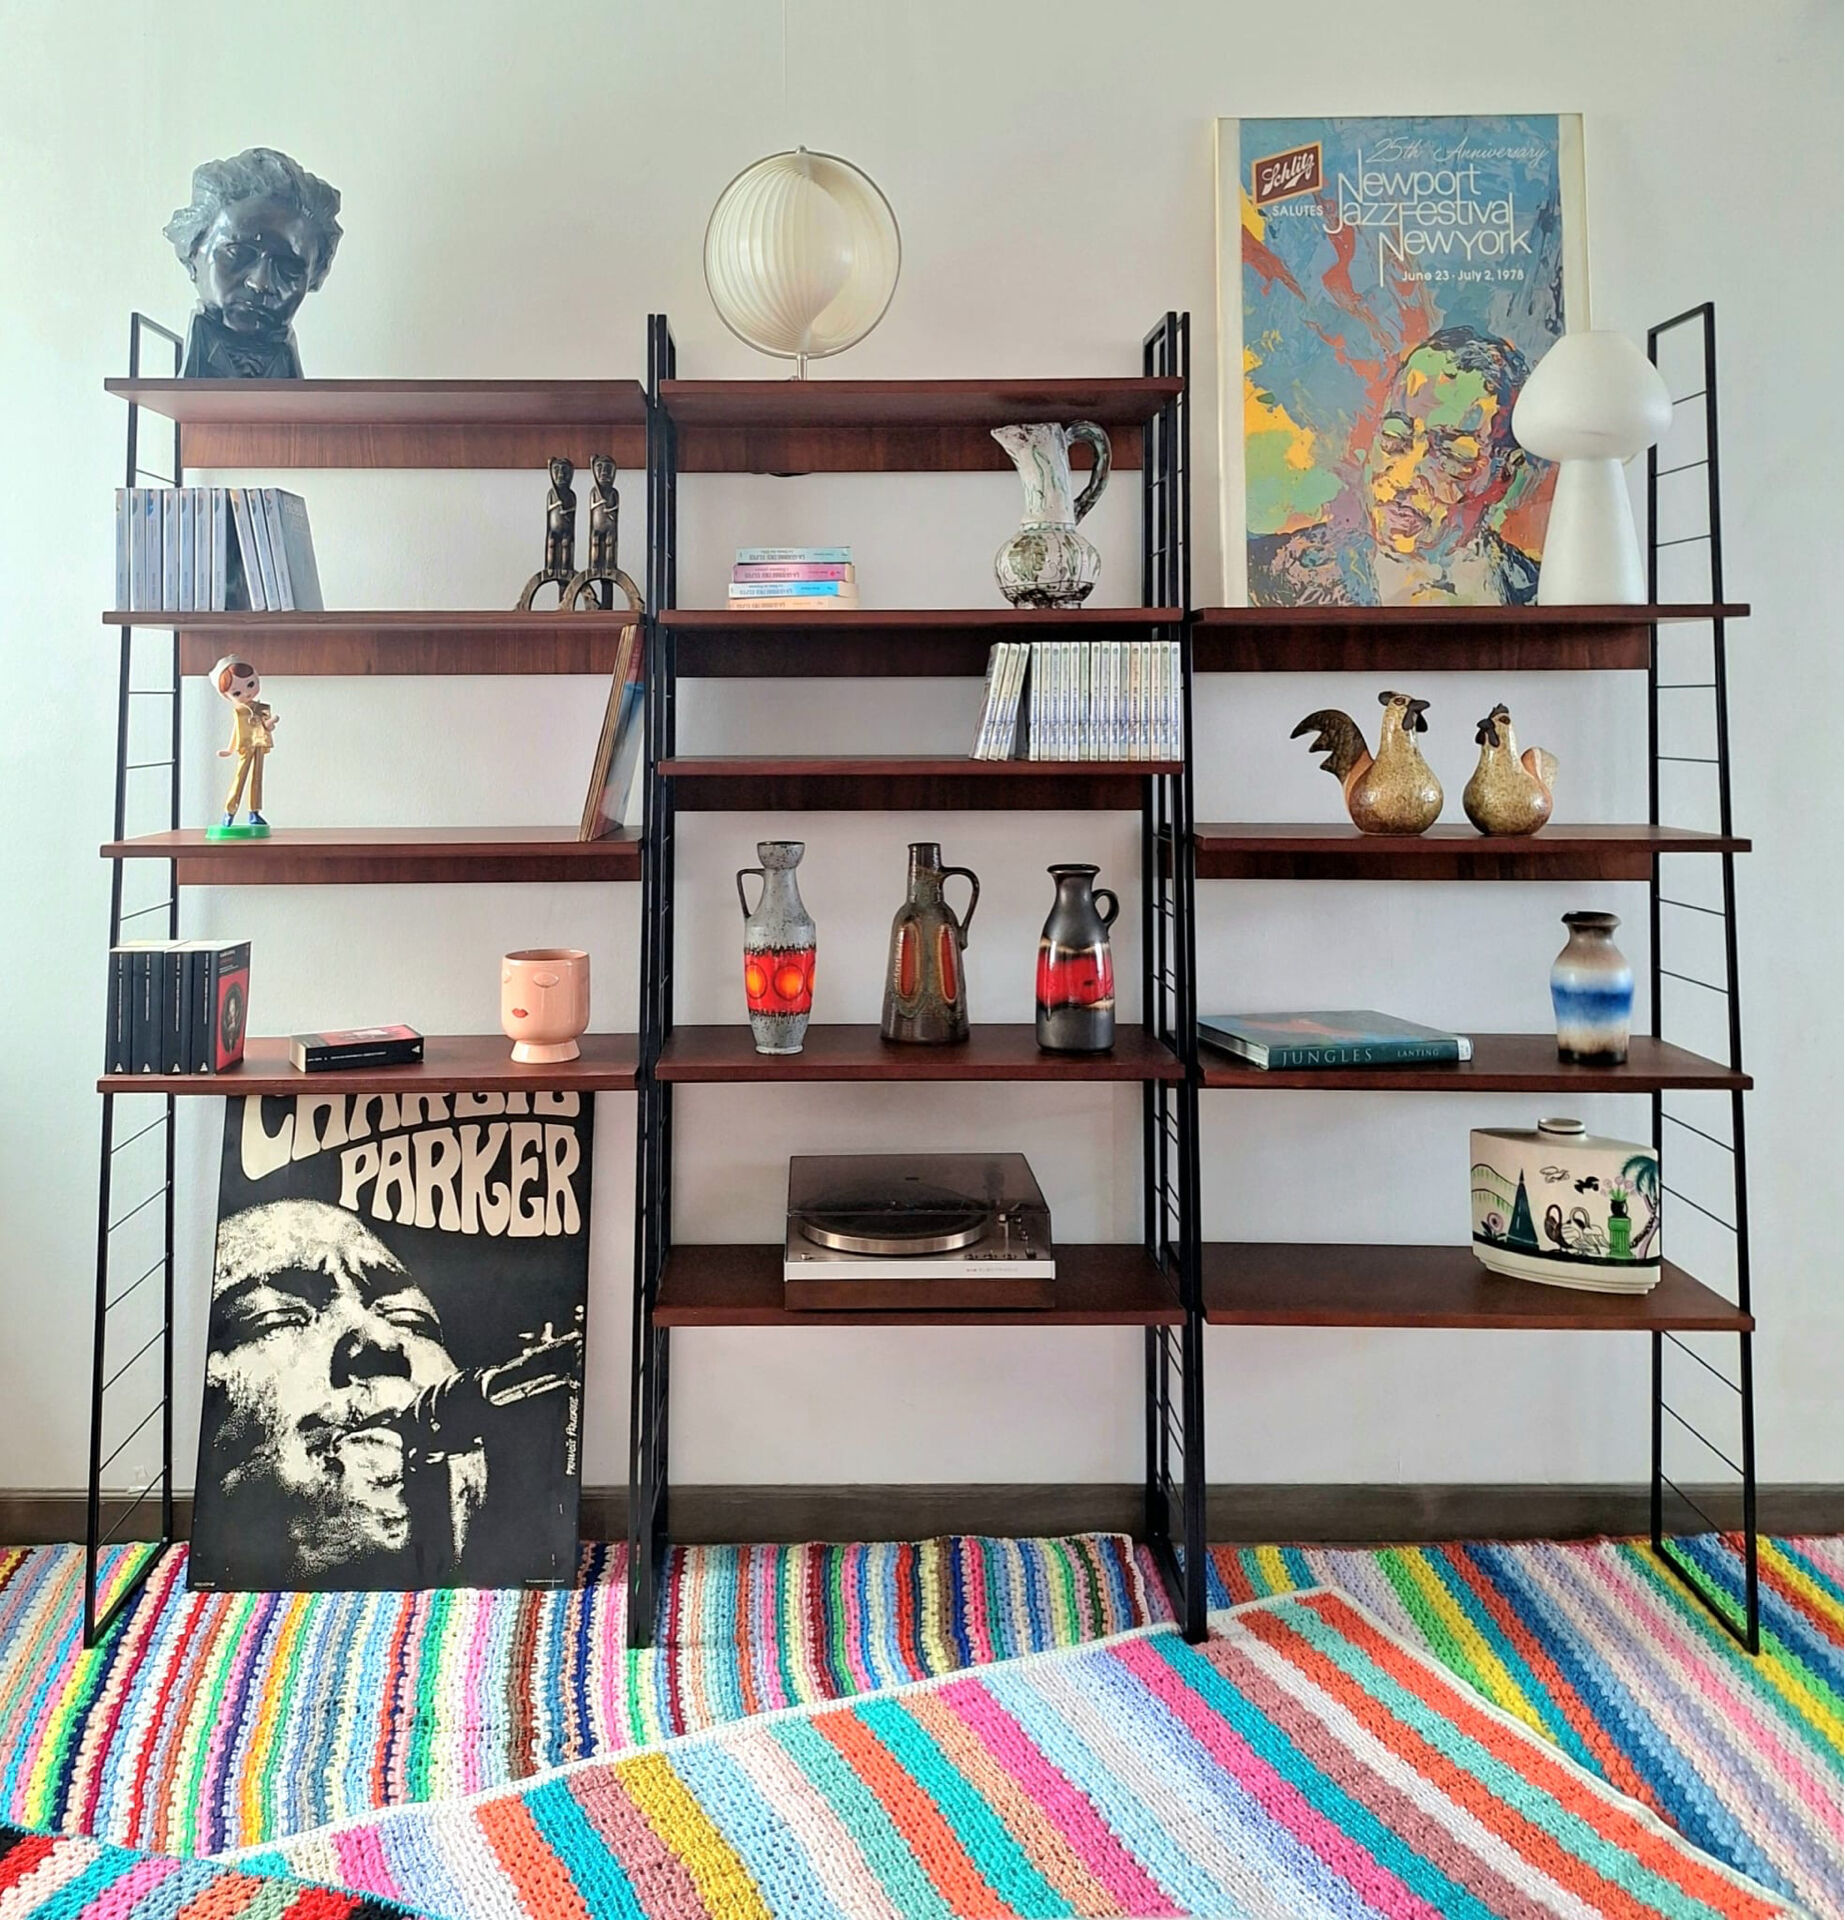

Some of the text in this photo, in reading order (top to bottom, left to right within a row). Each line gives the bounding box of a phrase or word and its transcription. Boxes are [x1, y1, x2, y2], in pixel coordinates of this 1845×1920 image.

[1365, 136, 1549, 167] 25th Anniversary
[1261, 152, 1315, 196] Schlitz
[1338, 148, 1482, 204] Newport
[1272, 204, 1324, 217] SALUTES
[1402, 270, 1432, 281] June
[1435, 270, 1449, 281] 23
[1458, 269, 1481, 282] July
[1497, 269, 1524, 281] 1978
[1281, 1048, 1439, 1067] JUNGLES LANTING
[338, 1122, 581, 1238] PARKER
